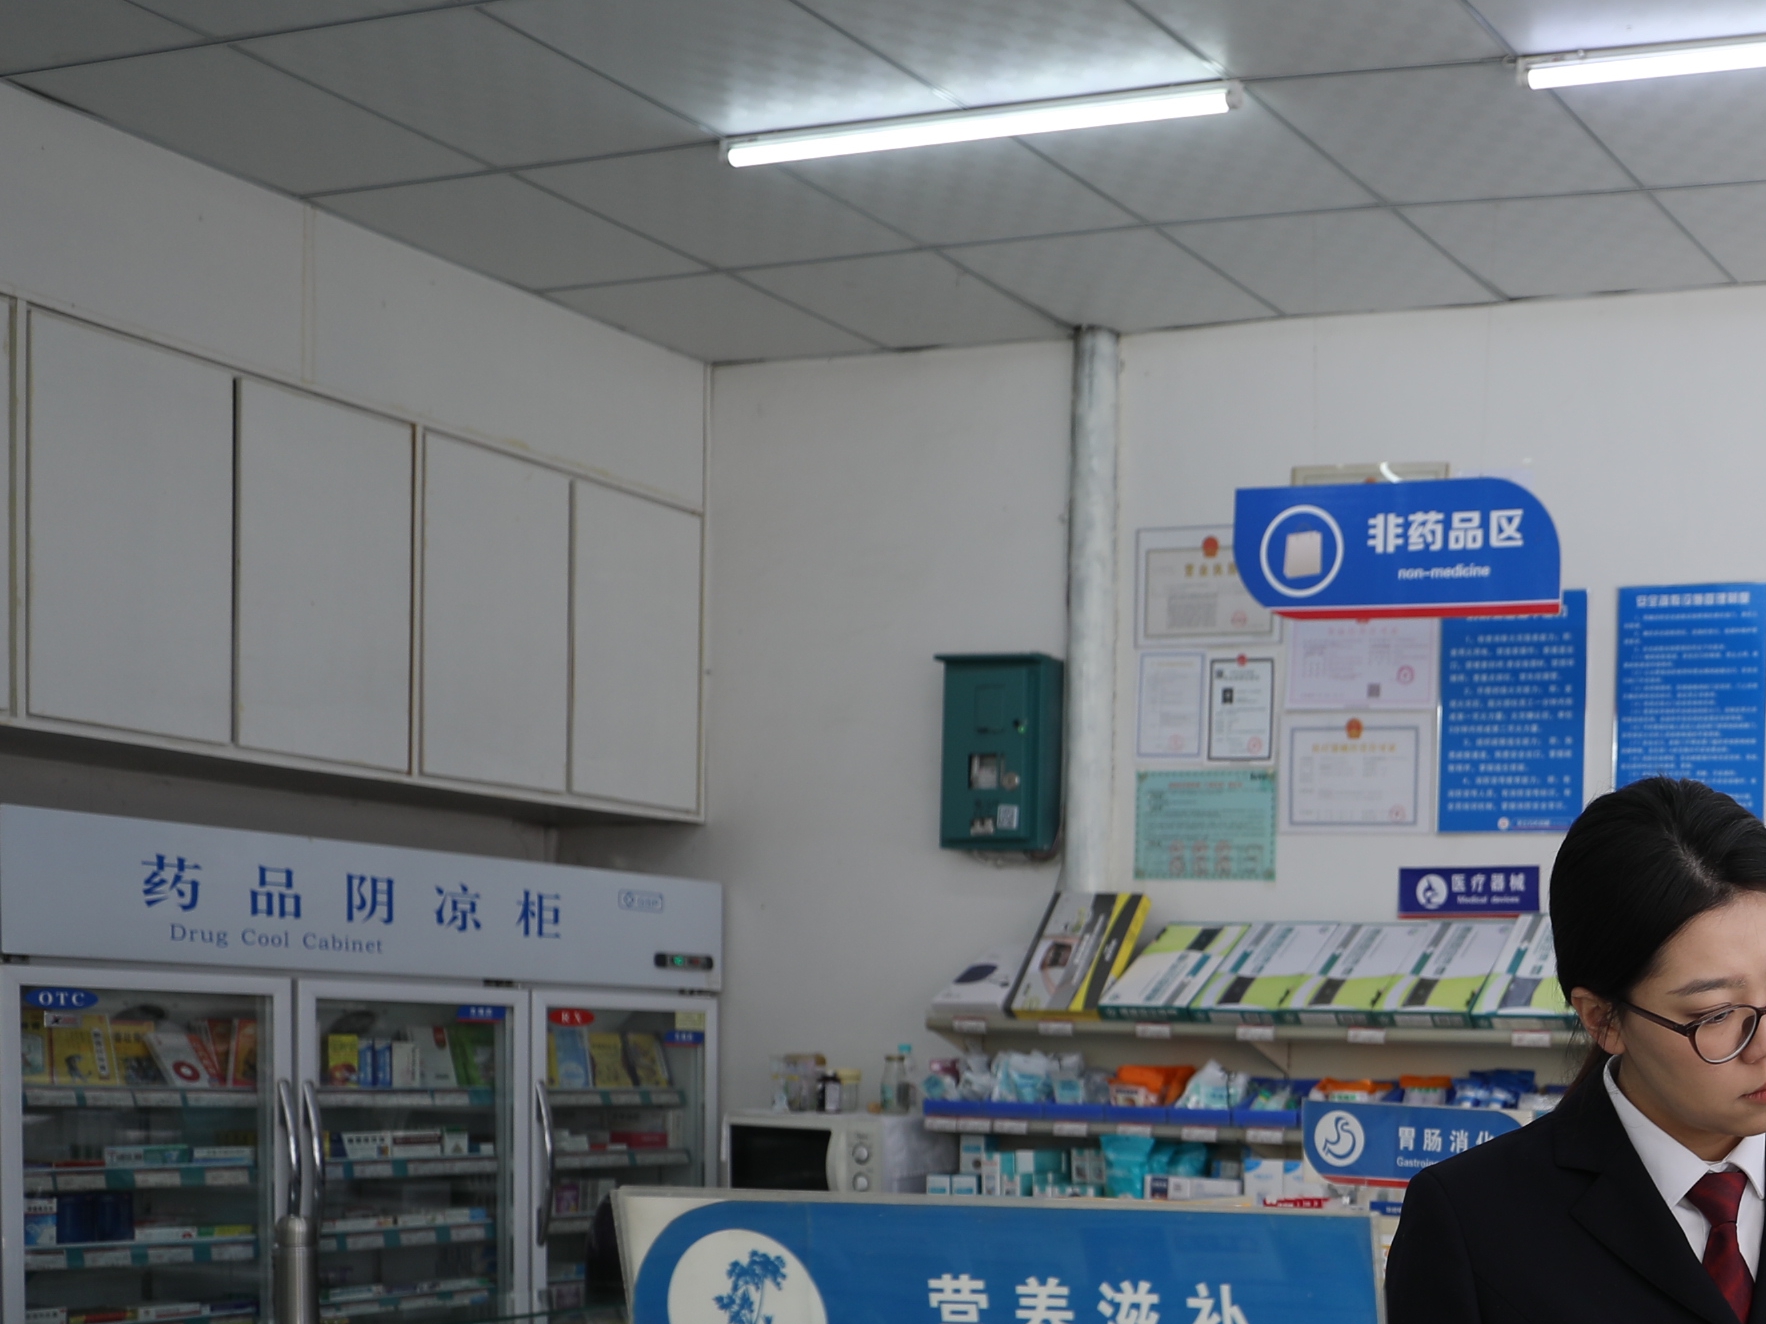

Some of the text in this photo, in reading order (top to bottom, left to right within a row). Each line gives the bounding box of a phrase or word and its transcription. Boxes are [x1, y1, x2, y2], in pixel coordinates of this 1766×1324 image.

[1367, 509, 1524, 554] 非药品区
[1398, 564, 1490, 580] non-medicine
[1451, 873, 1525, 893] 医疗器械
[141, 853, 562, 940] 药品阴凉柜
[169, 923, 383, 954] Drug Cool Cabinet
[39, 991, 86, 1007] OTC
